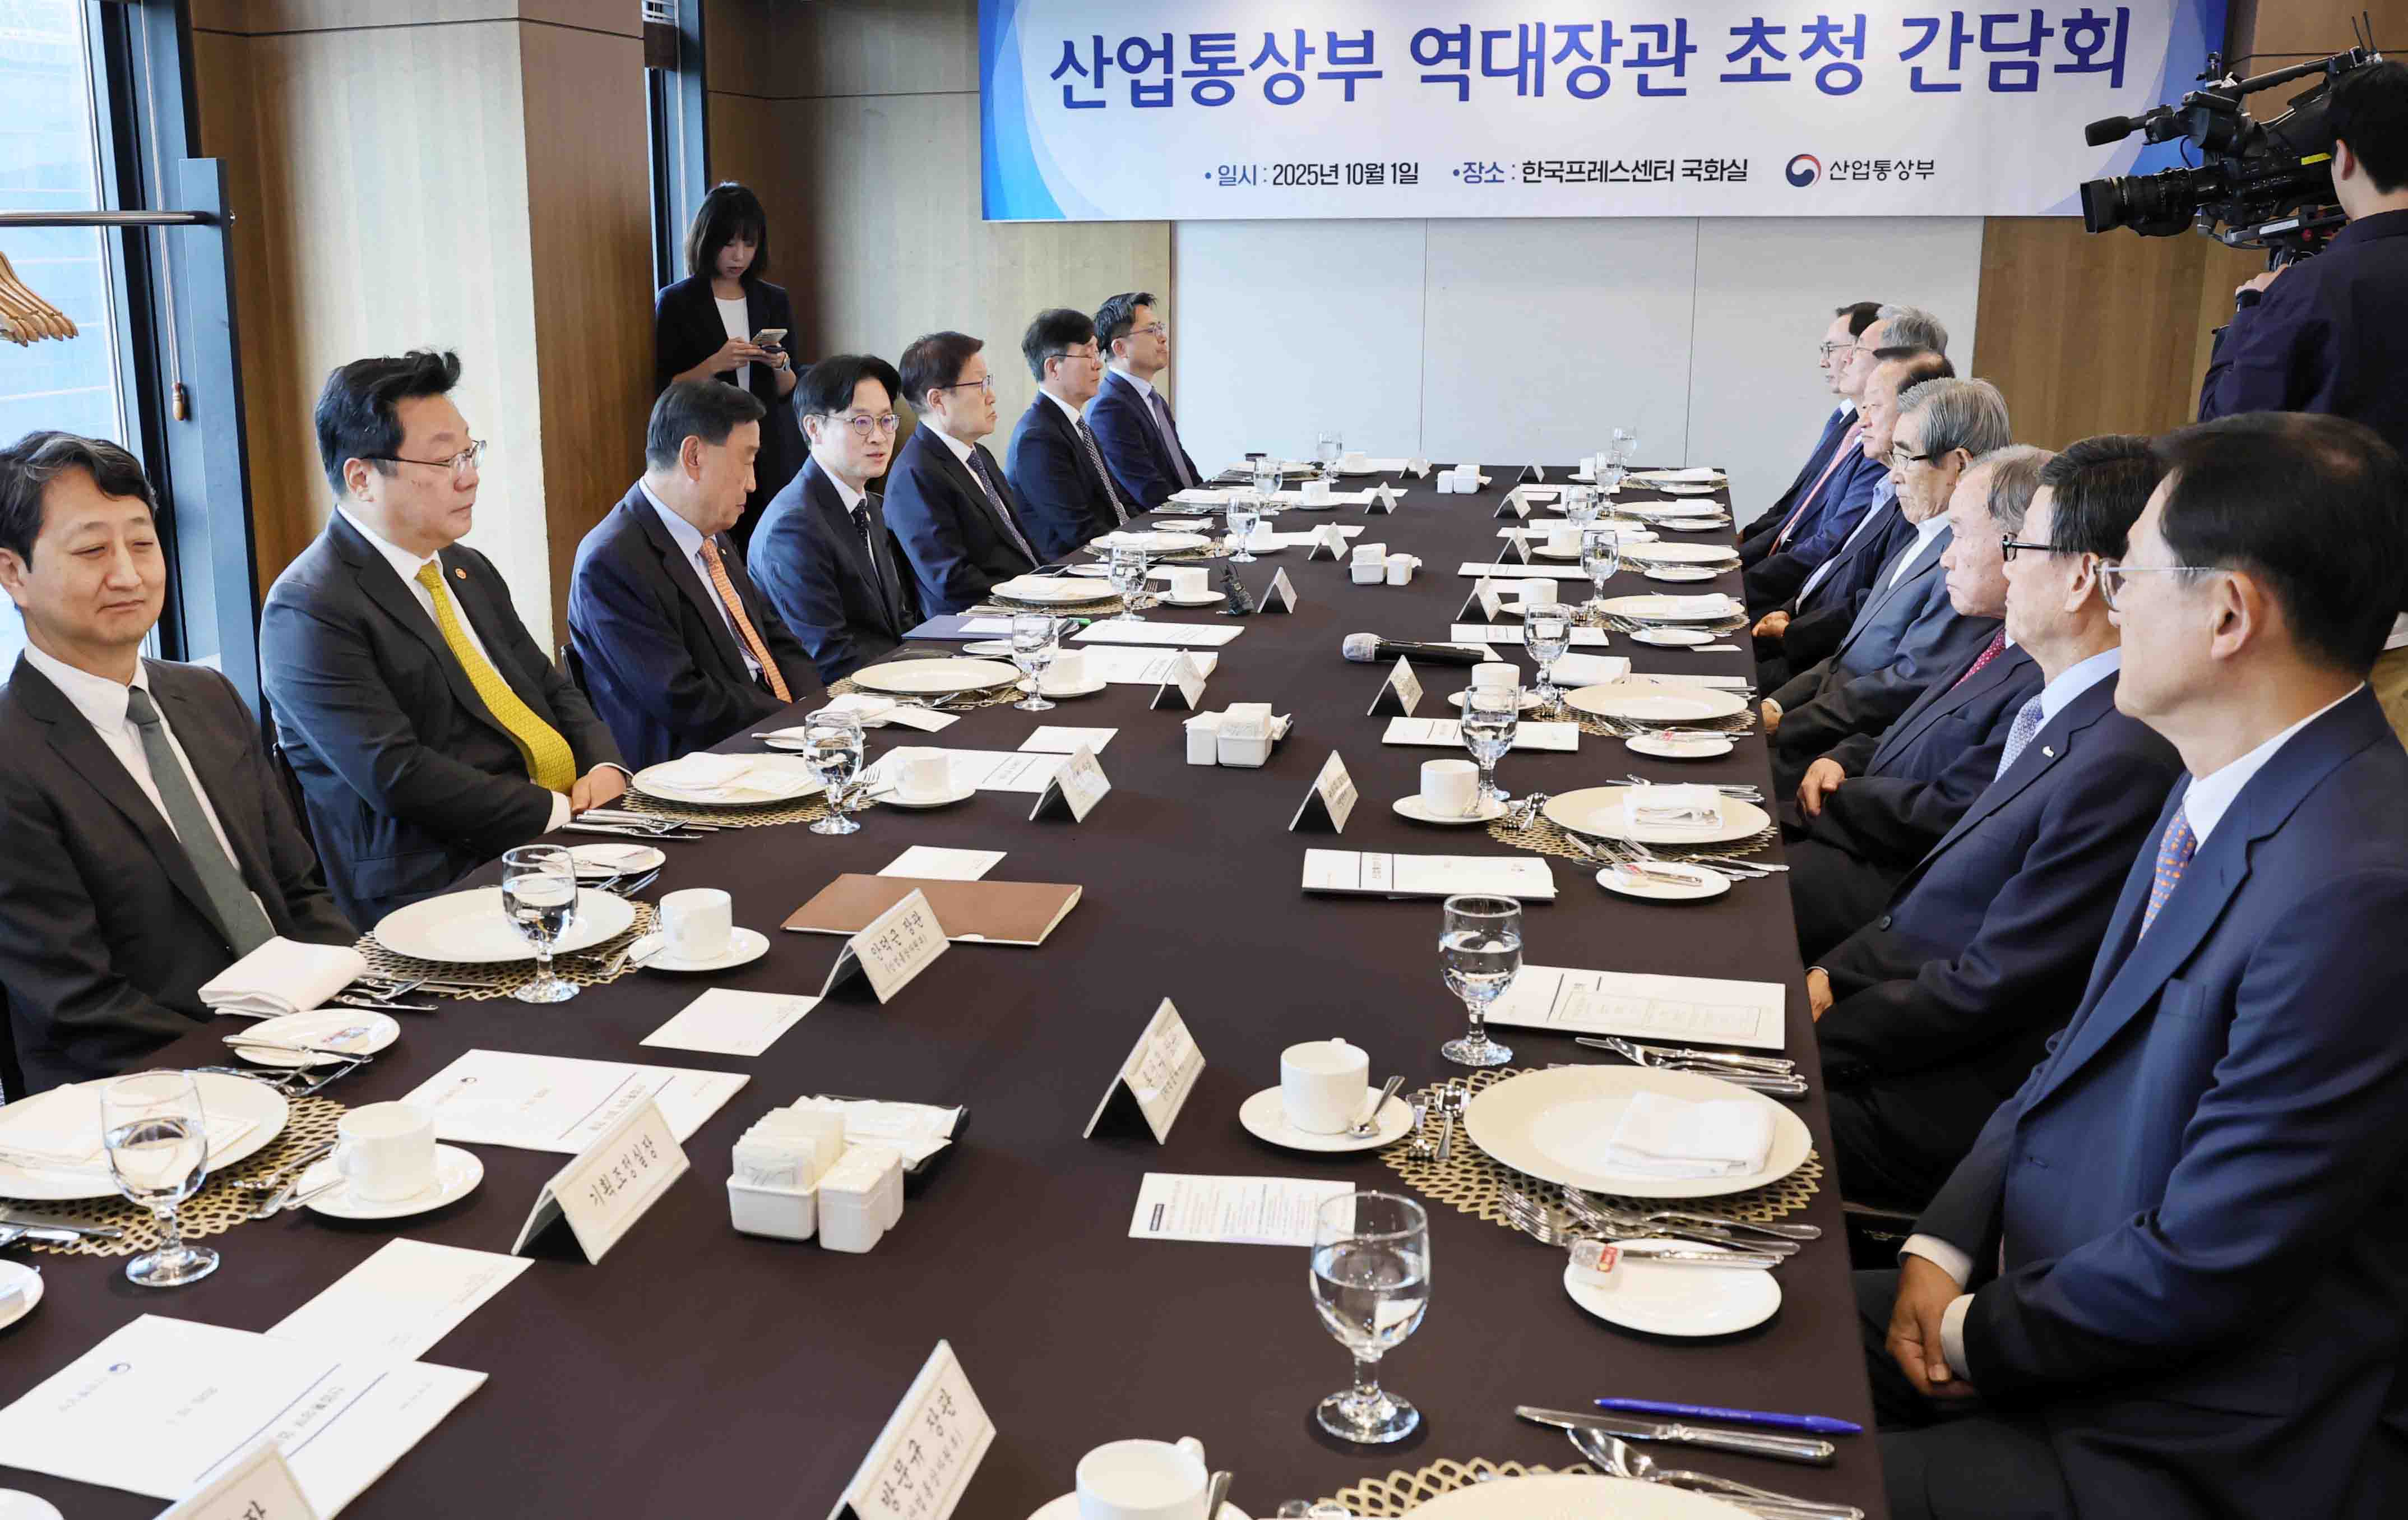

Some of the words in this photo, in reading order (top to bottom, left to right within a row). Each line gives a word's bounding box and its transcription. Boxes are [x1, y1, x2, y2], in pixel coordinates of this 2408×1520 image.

[1050, 29, 1382, 109] 산업통상부
[1410, 17, 1697, 101] 역대장관
[1720, 13, 1866, 95] 초청
[1898, 7, 2130, 92] 간담회
[1217, 164, 1257, 186] 일시
[1272, 163, 1339, 186] 2025년
[1345, 163, 1384, 185] 10월
[1391, 162, 1419, 184] 1일
[1462, 161, 1504, 184] 장소
[1522, 159, 1674, 183] 한국프레스센터
[1682, 158, 1748, 182] 국화실
[1830, 160, 1935, 181] 산업통상부
[870, 928, 902, 961] 안덕근
[902, 911, 924, 936] 장관
[589, 1134, 657, 1207] 기획조정실장
[881, 1439, 924, 1512] 방문규
[926, 1388, 956, 1437] 장관
